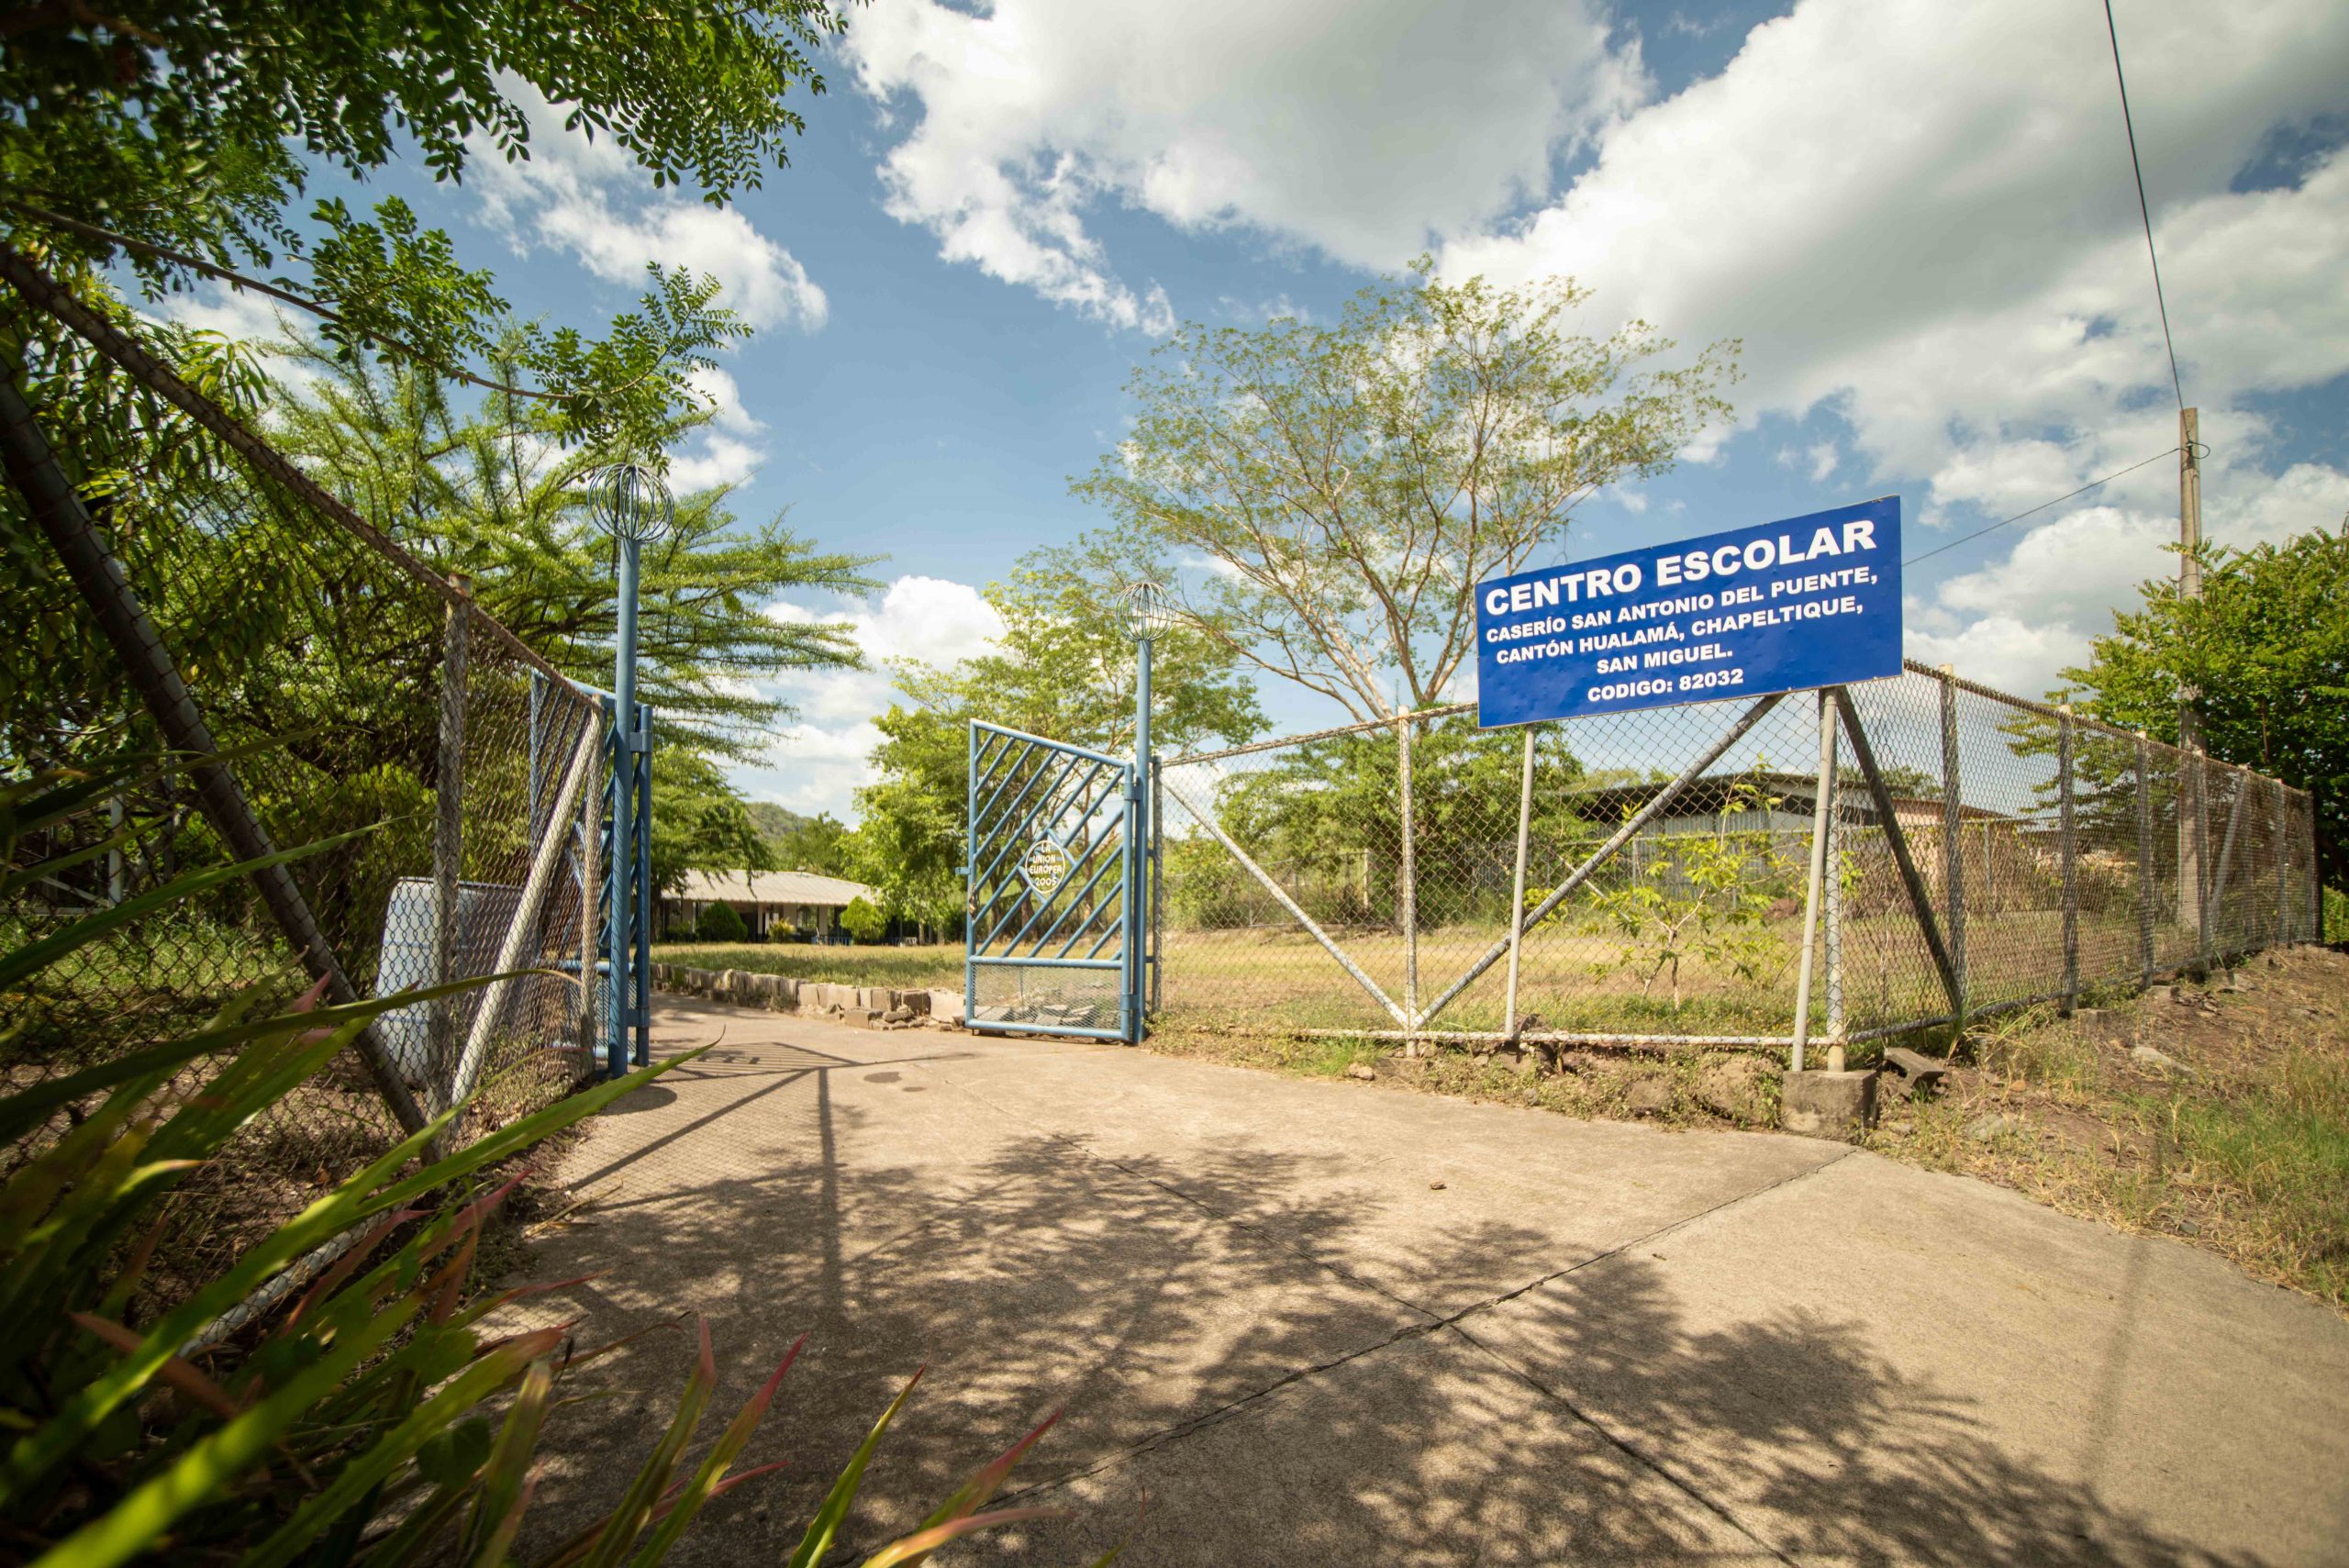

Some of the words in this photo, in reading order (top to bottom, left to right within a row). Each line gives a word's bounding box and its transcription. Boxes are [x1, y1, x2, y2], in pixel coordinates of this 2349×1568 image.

[1485, 563, 1642, 616] CENTRO
[1656, 519, 1877, 587] ESCOLAR
[1486, 616, 1566, 643] CASERÍO
[1571, 609, 1612, 630] SAN
[1617, 594, 1715, 623] ANTONIO
[1720, 585, 1765, 607] DEL
[1771, 565, 1878, 598] PUENTE,
[1496, 639, 1574, 664] CANTÓN
[1579, 621, 1686, 653] HUALAMÁ,
[1691, 595, 1865, 637] CHAPELTIQUE,
[1597, 654, 1638, 674] SAN
[1643, 642, 1733, 669] MIGUEL.
[1587, 678, 1674, 703] CODIGO:
[1678, 668, 1744, 691] 82032
[1032, 854, 1056, 864] UNION
[1041, 843, 1051, 853] LA
[1030, 864, 1063, 874] EUROPEA
[1035, 877, 1058, 886] 2005
